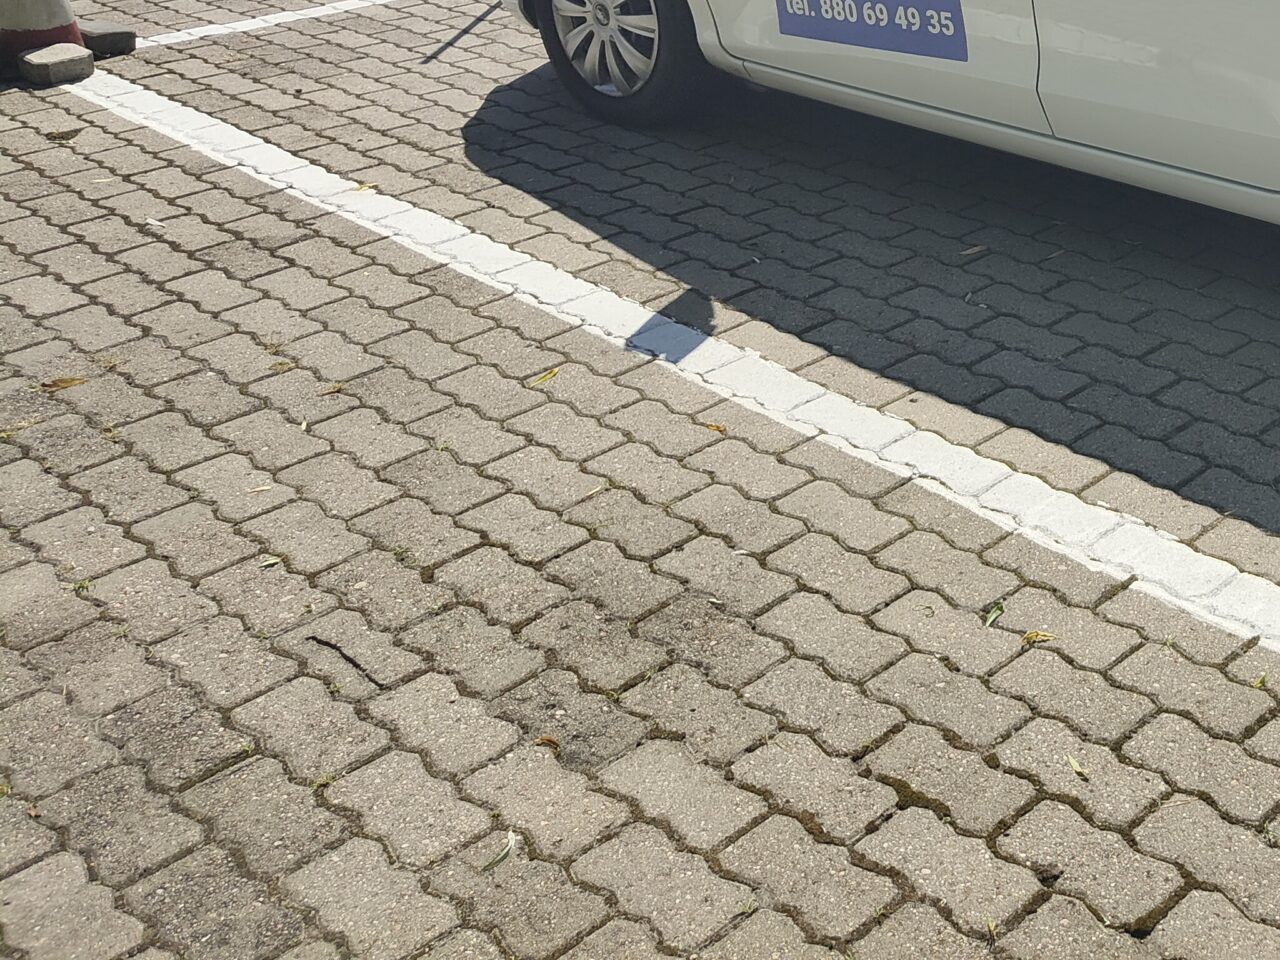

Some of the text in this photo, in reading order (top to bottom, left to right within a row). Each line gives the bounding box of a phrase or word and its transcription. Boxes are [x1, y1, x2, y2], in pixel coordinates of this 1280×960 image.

[862, 2, 889, 27] 69
[894, 6, 921, 31] 49
[927, 9, 955, 36] 35
